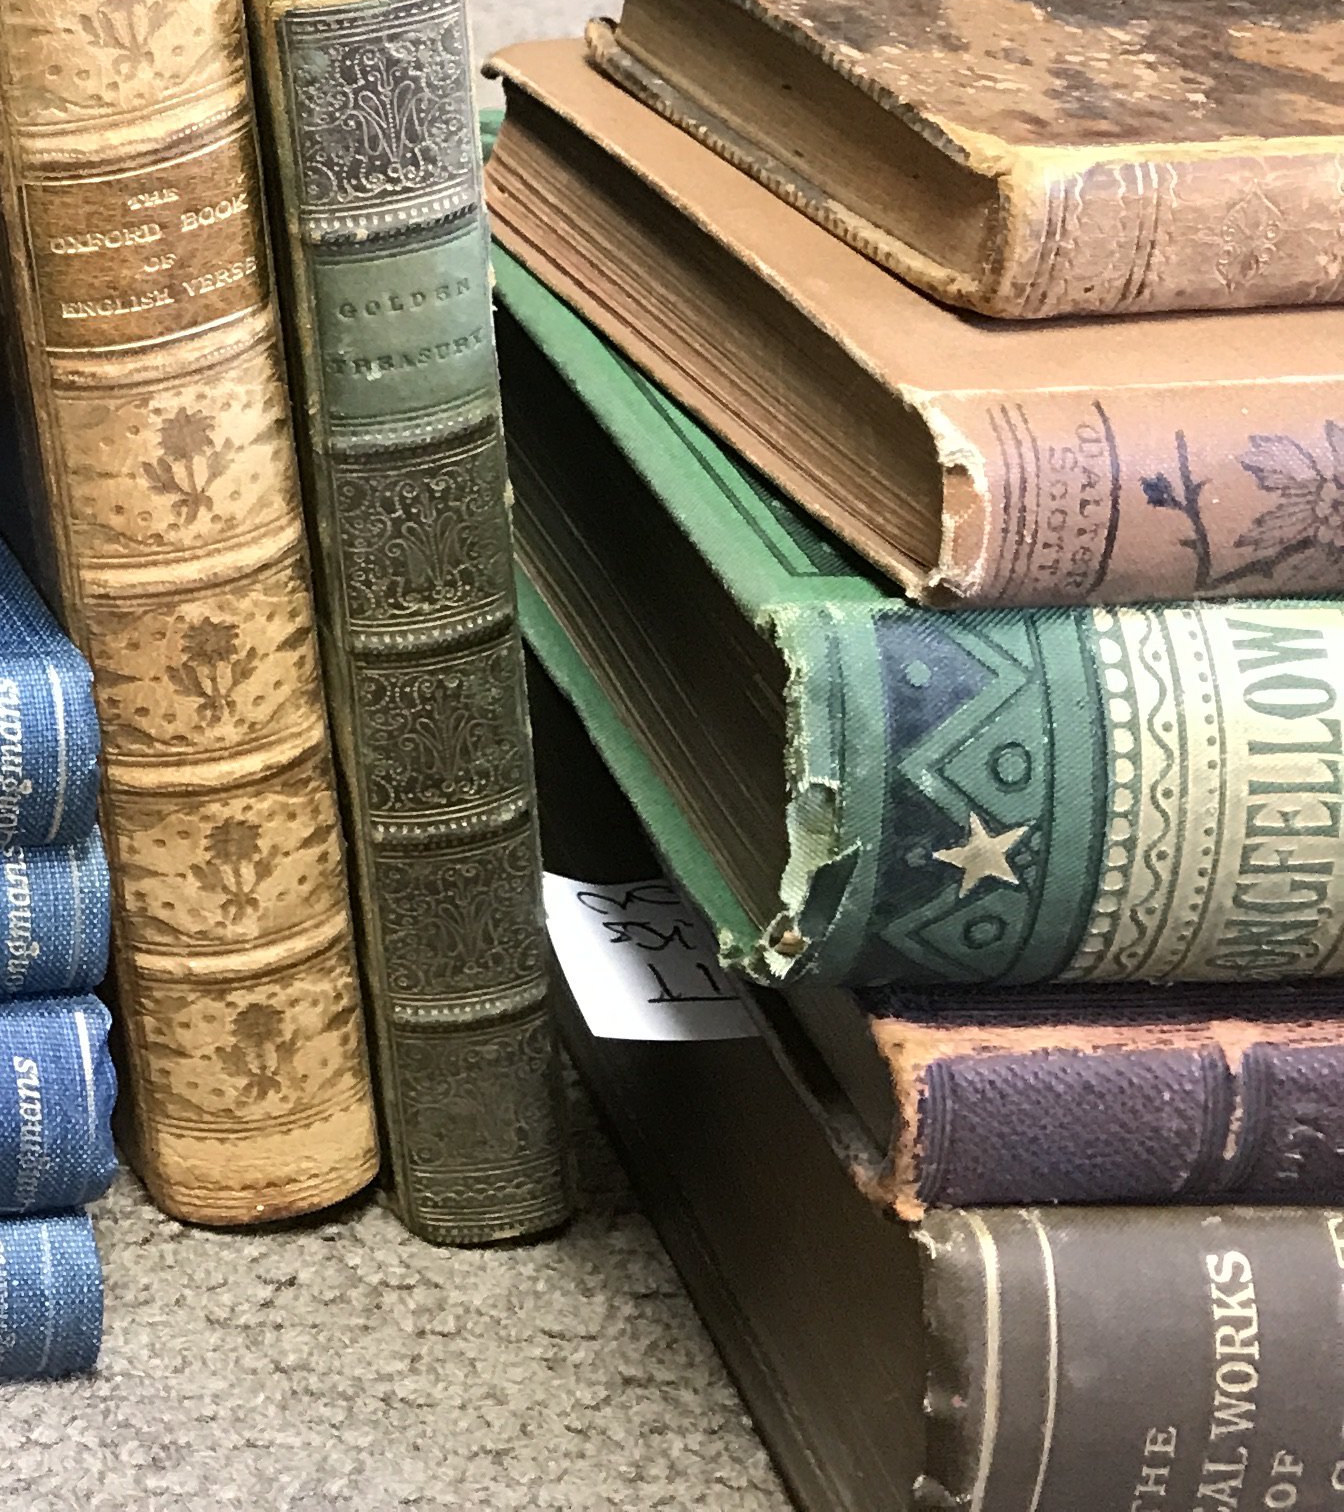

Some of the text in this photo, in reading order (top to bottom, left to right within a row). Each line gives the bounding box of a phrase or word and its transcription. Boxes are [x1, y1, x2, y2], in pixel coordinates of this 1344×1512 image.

[50, 192, 249, 254] OXFORD BOOK
[127, 187, 180, 210] THE
[61, 255, 257, 319] ENGLISH VERSE
[143, 253, 178, 273] OF
[338, 277, 471, 319] GOLDEN
[329, 327, 484, 376] TREASURY
[1206, 1249, 1260, 1442] WORKS
[1264, 1449, 1305, 1510] OF
